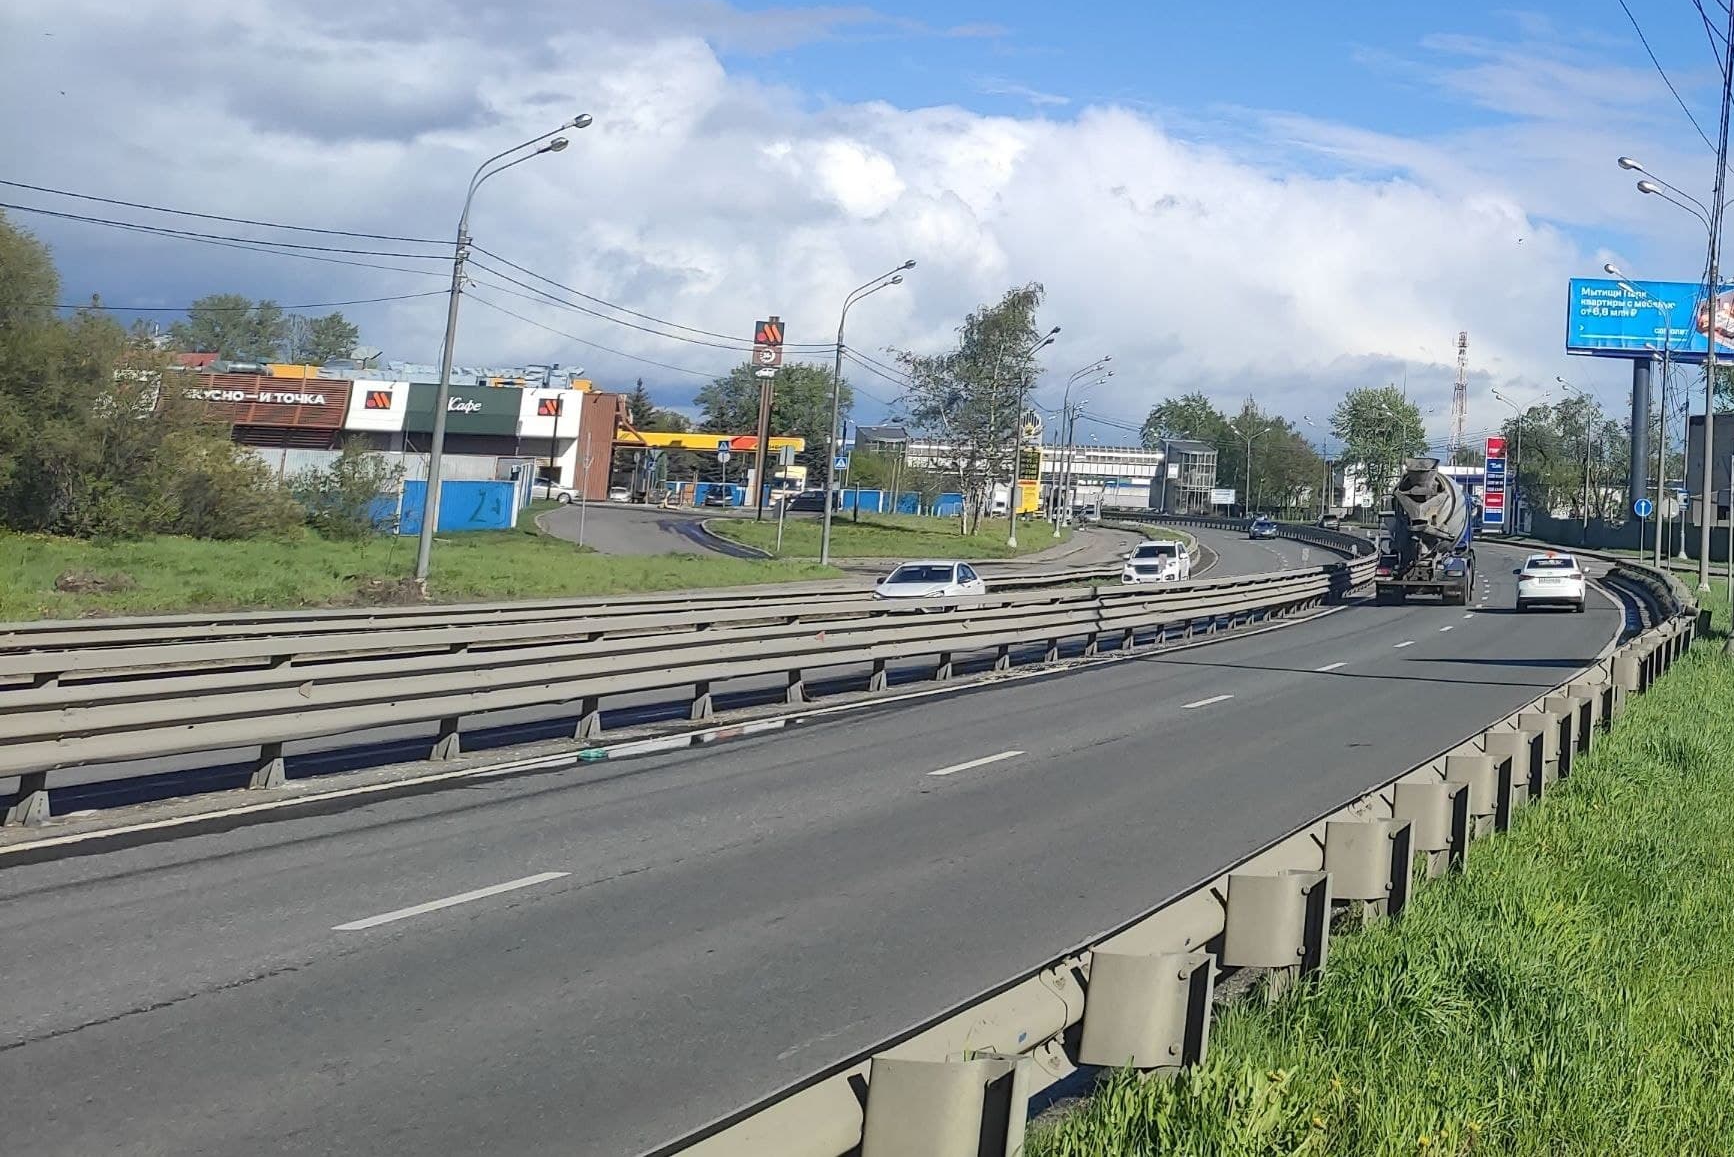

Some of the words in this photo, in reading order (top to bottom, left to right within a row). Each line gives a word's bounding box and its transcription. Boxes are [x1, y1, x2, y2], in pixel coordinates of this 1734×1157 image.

[1581, 287, 1621, 298] Мытищи
[1580, 298, 1625, 308] квартиры
[259, 393, 271, 402] И
[273, 393, 326, 405] ТОЧКА
[447, 397, 482, 414] Кафе
